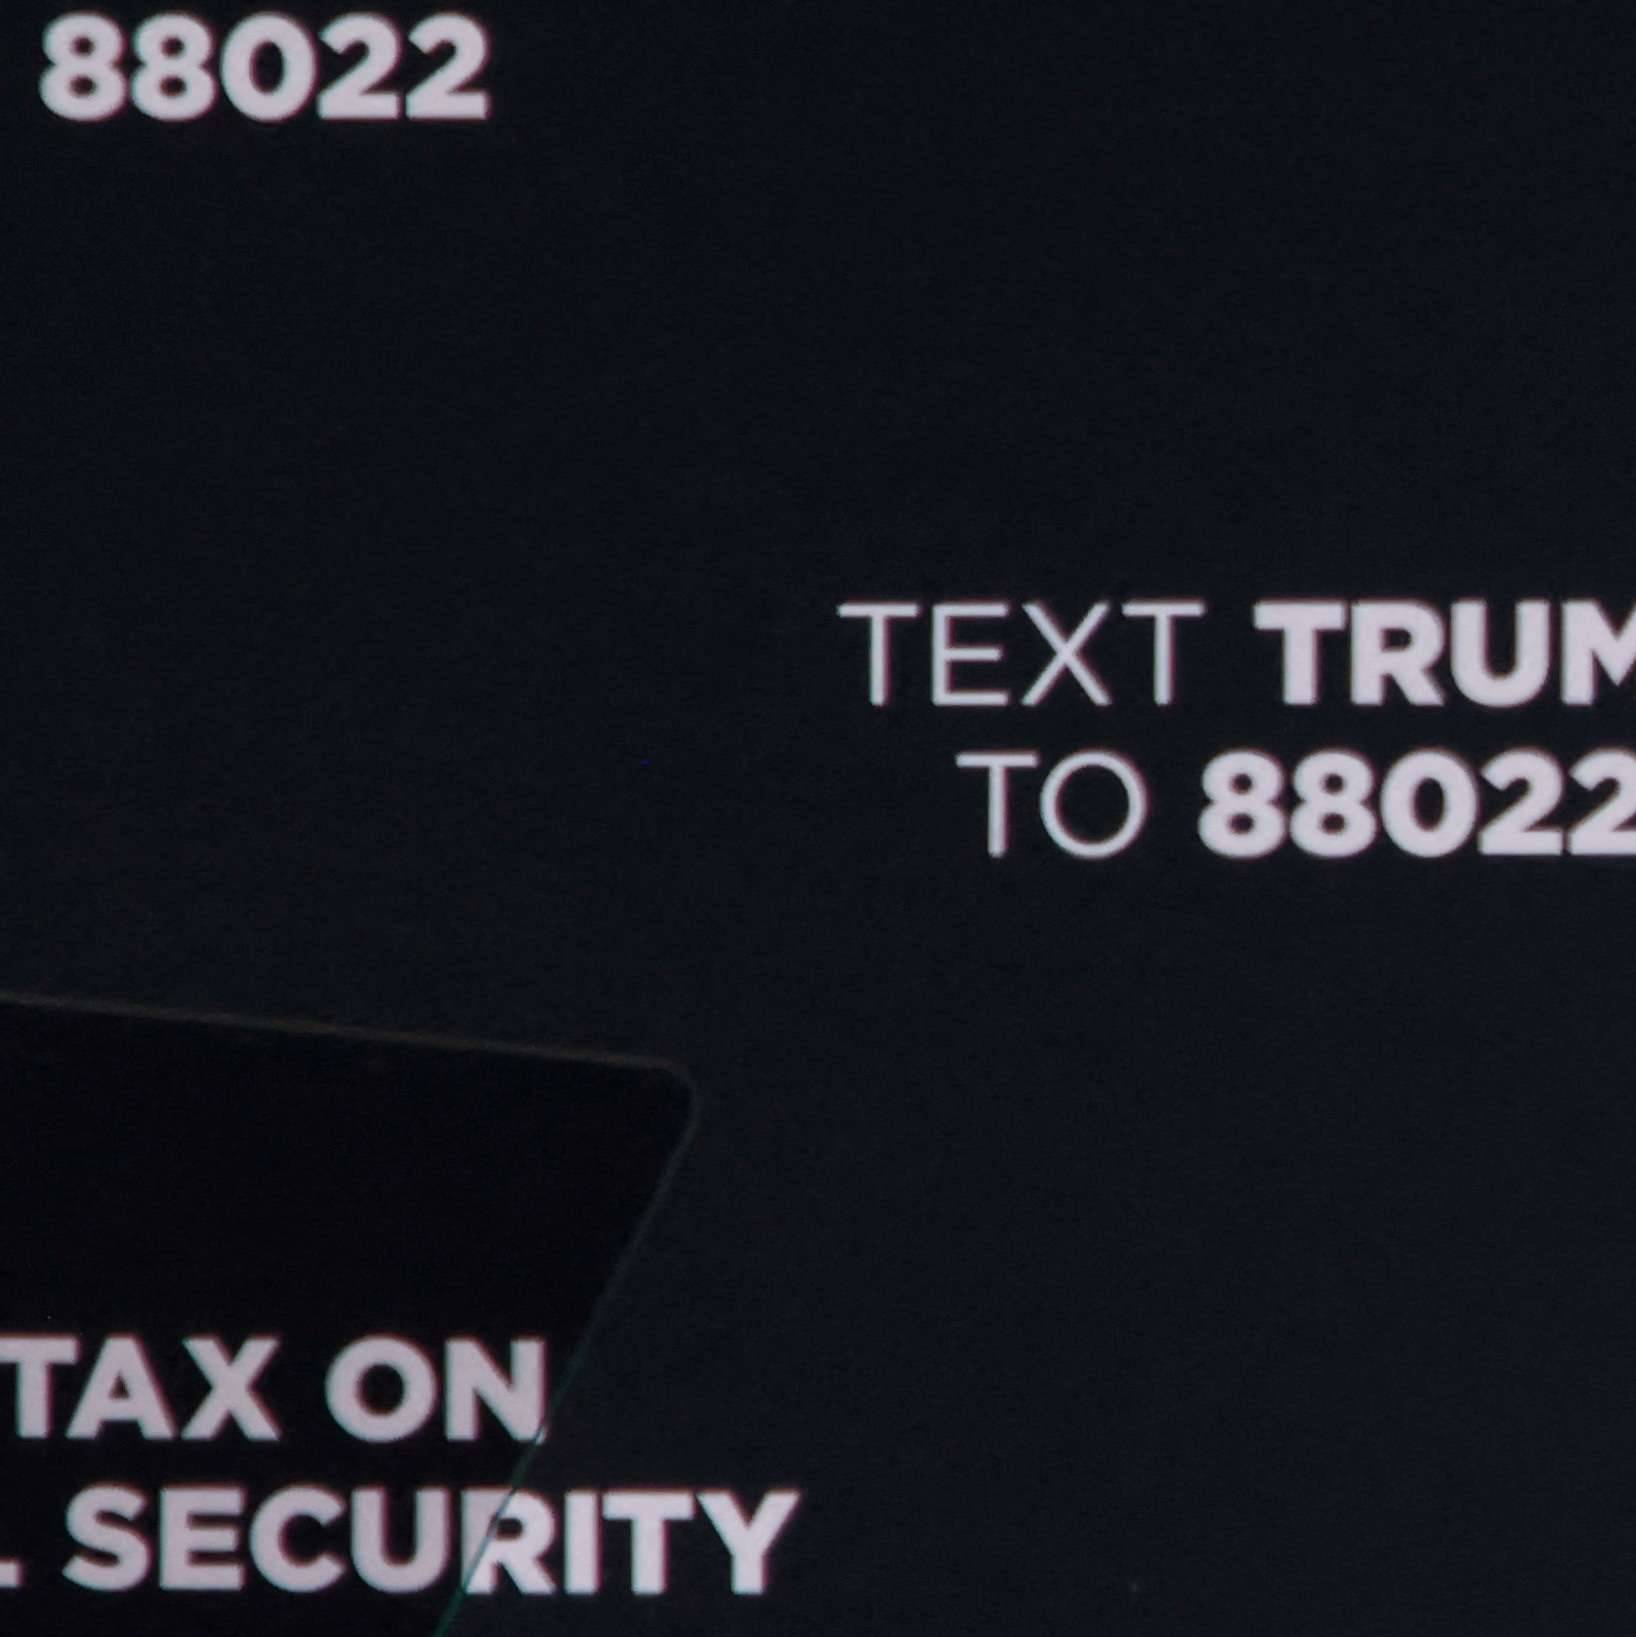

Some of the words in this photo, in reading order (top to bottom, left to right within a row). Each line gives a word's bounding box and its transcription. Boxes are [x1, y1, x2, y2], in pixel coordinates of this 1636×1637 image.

[40, 12, 489, 122] 88022
[836, 601, 1206, 708] TEXT
[954, 749, 1148, 860] TO
[0, 1334, 278, 1441] TAX
[325, 1334, 546, 1443] ON
[63, 1484, 800, 1596] SECURITY
